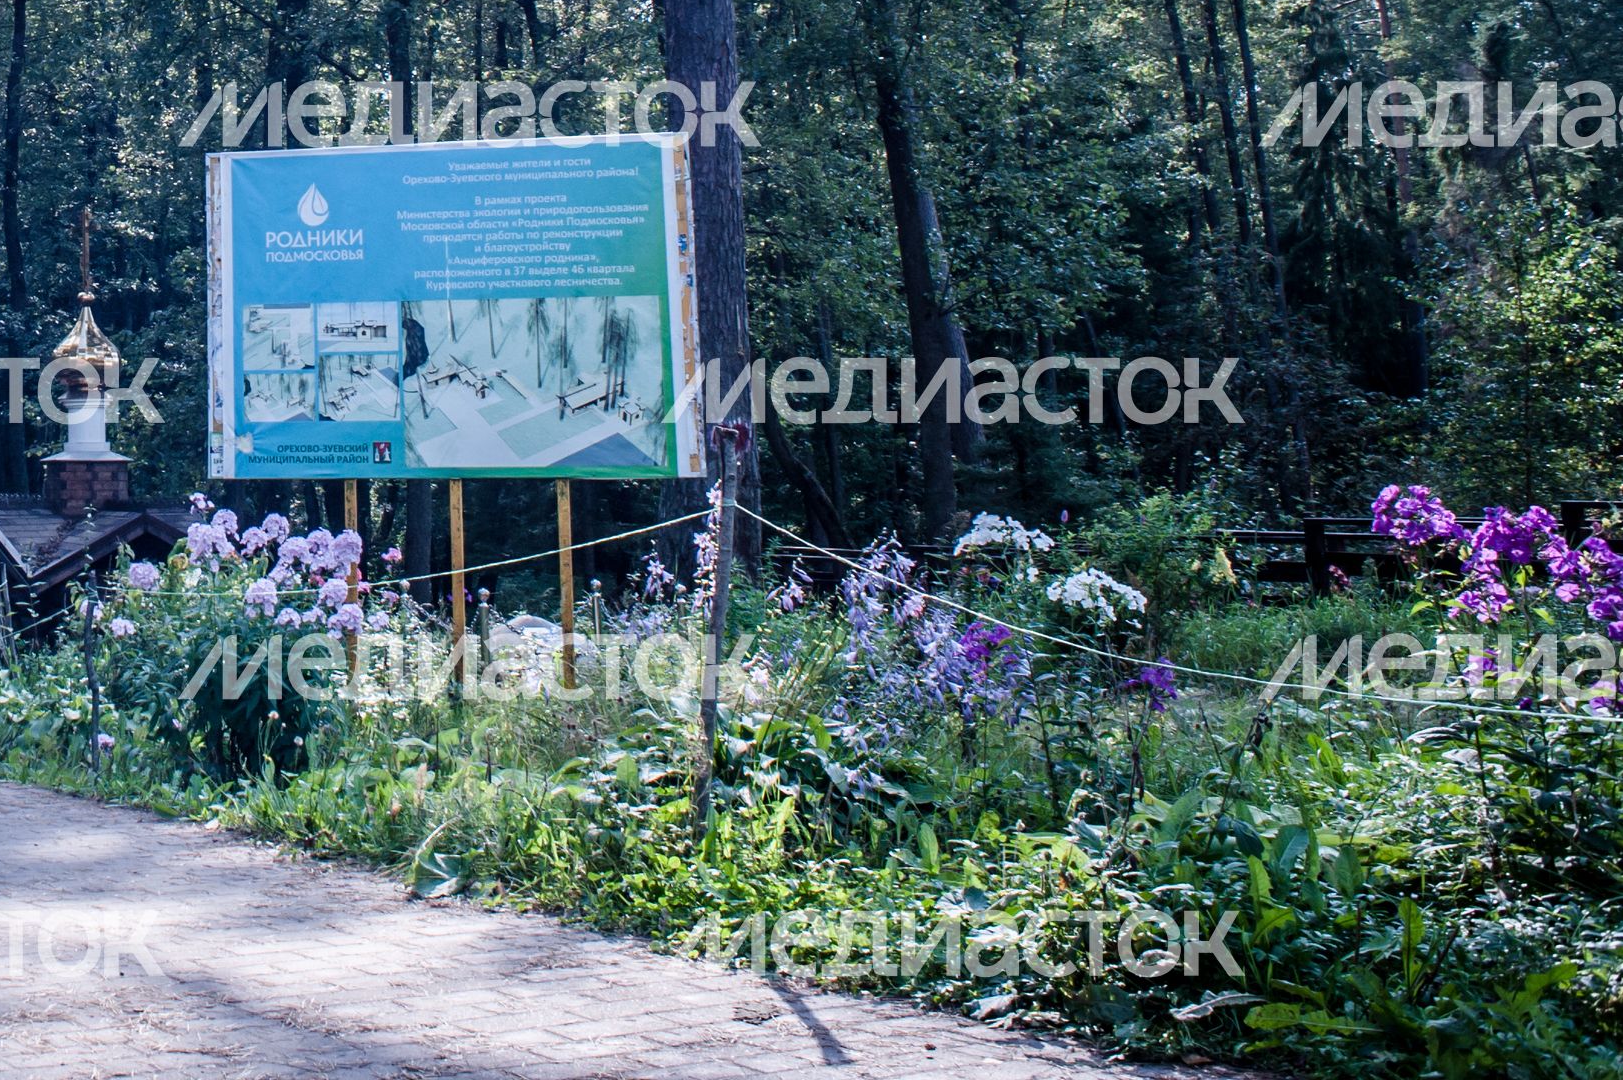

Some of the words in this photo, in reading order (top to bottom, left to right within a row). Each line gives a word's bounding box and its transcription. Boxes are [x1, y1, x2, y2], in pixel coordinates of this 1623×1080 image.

[448, 161, 509, 171] Уважаемые
[512, 160, 551, 169] жители
[553, 159, 561, 167] и
[563, 158, 591, 167] гости
[402, 172, 502, 186] Орехово-Зуевского
[504, 168, 594, 181] муниципального
[596, 166, 639, 179] района!
[474, 196, 482, 206] В
[484, 196, 522, 207] рамках
[524, 194, 567, 205] проекта
[396, 210, 471, 220] Министерства
[473, 208, 521, 217] экологии
[523, 208, 530, 216] и
[533, 204, 649, 217] природопользования
[400, 221, 464, 231] Московской
[466, 219, 509, 230] области
[512, 218, 564, 228] «Родники
[566, 216, 645, 227] Подмосковья»
[265, 229, 363, 248] РОДНИКИ
[422, 233, 483, 243] проводятся
[485, 230, 524, 242] работы
[526, 230, 540, 239] по
[542, 229, 623, 240] реконструкции
[474, 245, 482, 253] и
[484, 241, 571, 253] благоустройству
[265, 249, 364, 262] ПОДМОСКОВЬЯ
[414, 268, 502, 279] расположенного
[504, 268, 511, 276] в
[513, 266, 526, 275] 37
[528, 266, 569, 276] выделе
[571, 264, 585, 274] 46
[586, 265, 635, 274] квартала
[425, 280, 485, 291] Куровского
[488, 279, 551, 290] участкового
[553, 278, 623, 287] лесничества.
[277, 443, 369, 453] ОРЕХОВО-ЗУЕВСКИЙ
[248, 454, 335, 465] МУНИЦИПАЛЬНЫЙ
[337, 453, 369, 463] РАЙОН
